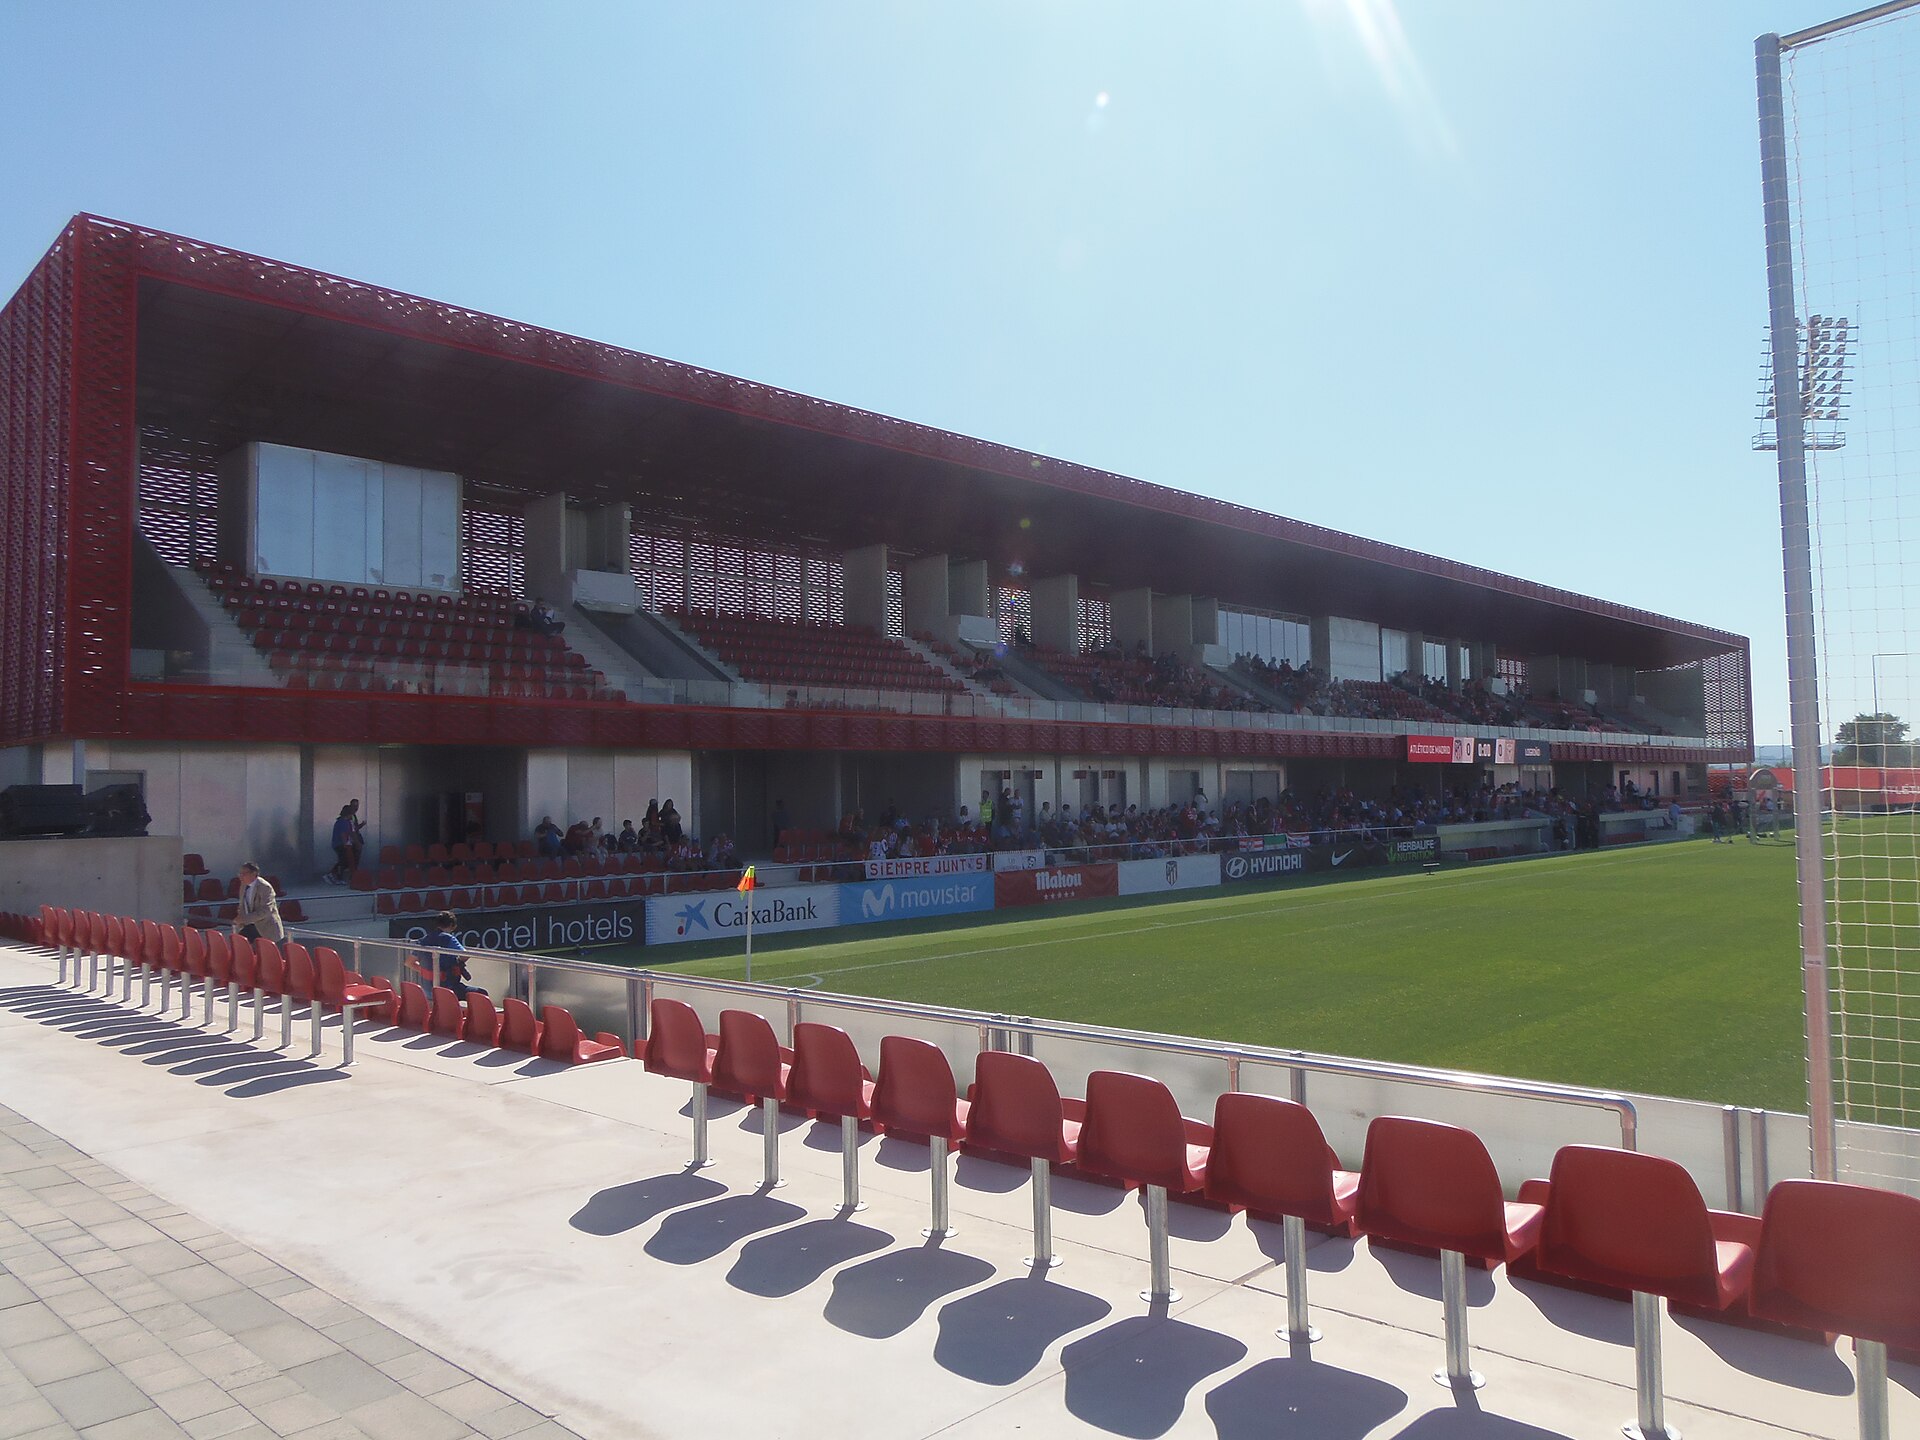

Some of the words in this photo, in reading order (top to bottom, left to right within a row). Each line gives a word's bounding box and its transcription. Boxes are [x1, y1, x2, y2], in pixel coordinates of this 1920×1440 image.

[1466, 742, 1471, 756] 0
[1498, 744, 1503, 757] 0
[1397, 841, 1435, 852] HERBALIFE
[1397, 850, 1435, 862] NUTRITION
[1250, 853, 1302, 874] HYUNDAI
[1035, 869, 1082, 891] Mahou
[901, 884, 977, 909] movistar
[714, 897, 818, 928] CaixaBank
[549, 910, 633, 944] hotels
